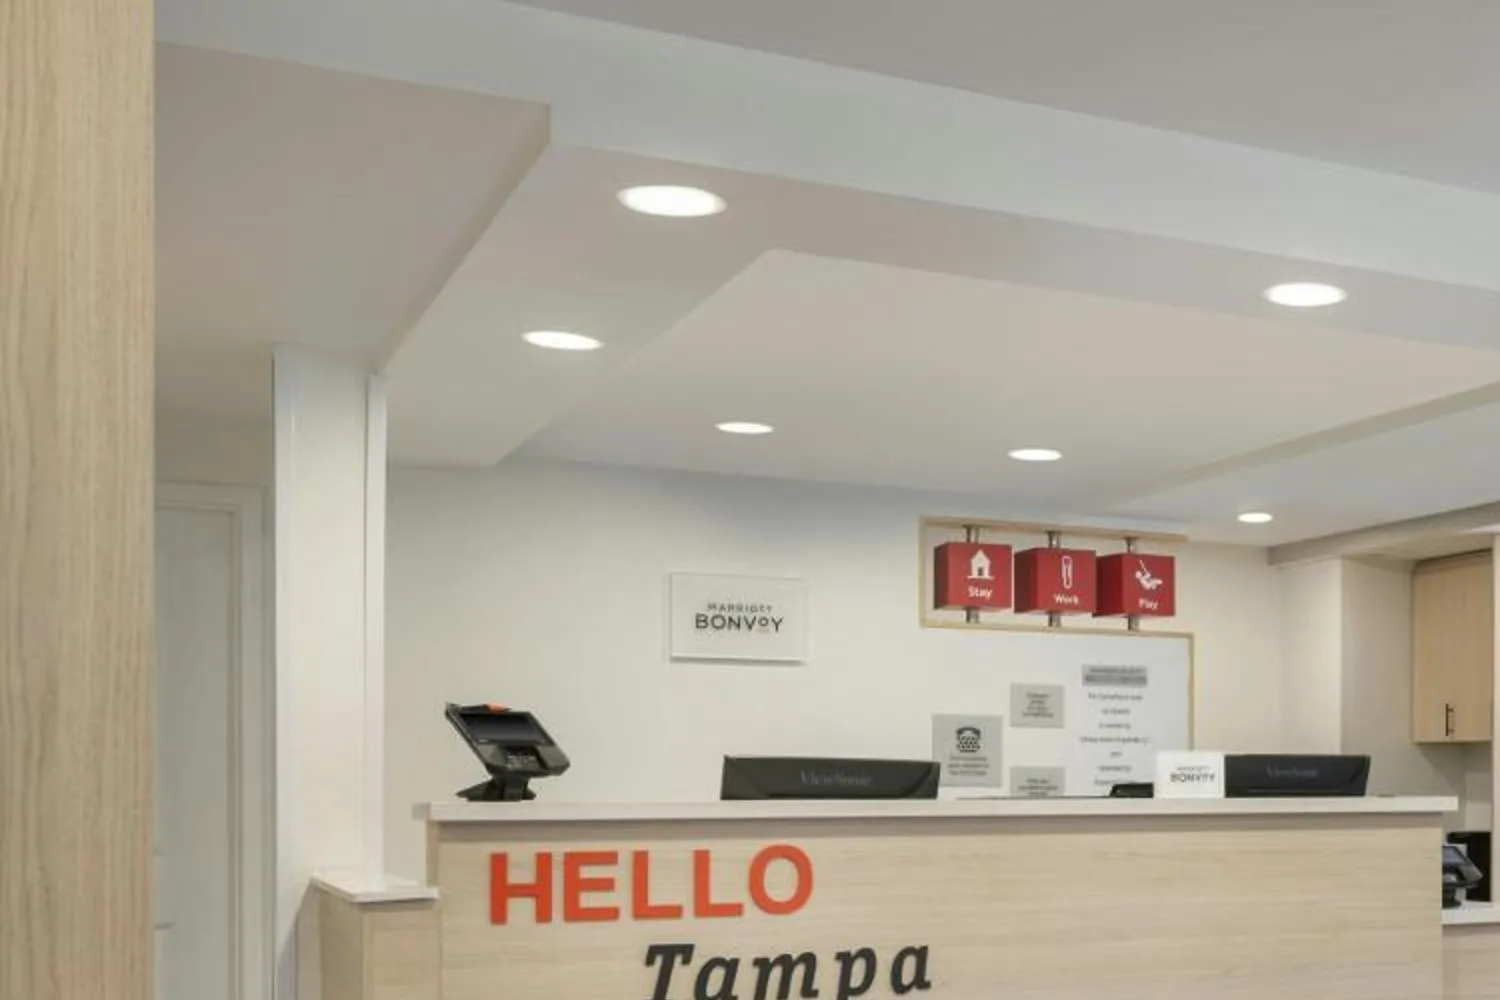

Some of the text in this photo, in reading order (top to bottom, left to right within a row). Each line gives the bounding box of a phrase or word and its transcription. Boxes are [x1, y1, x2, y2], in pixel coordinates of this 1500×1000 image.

[968, 587, 993, 600] Stay
[1054, 594, 1078, 605] Work
[1139, 599, 1158, 610] Play
[489, 844, 813, 925] HELLO
